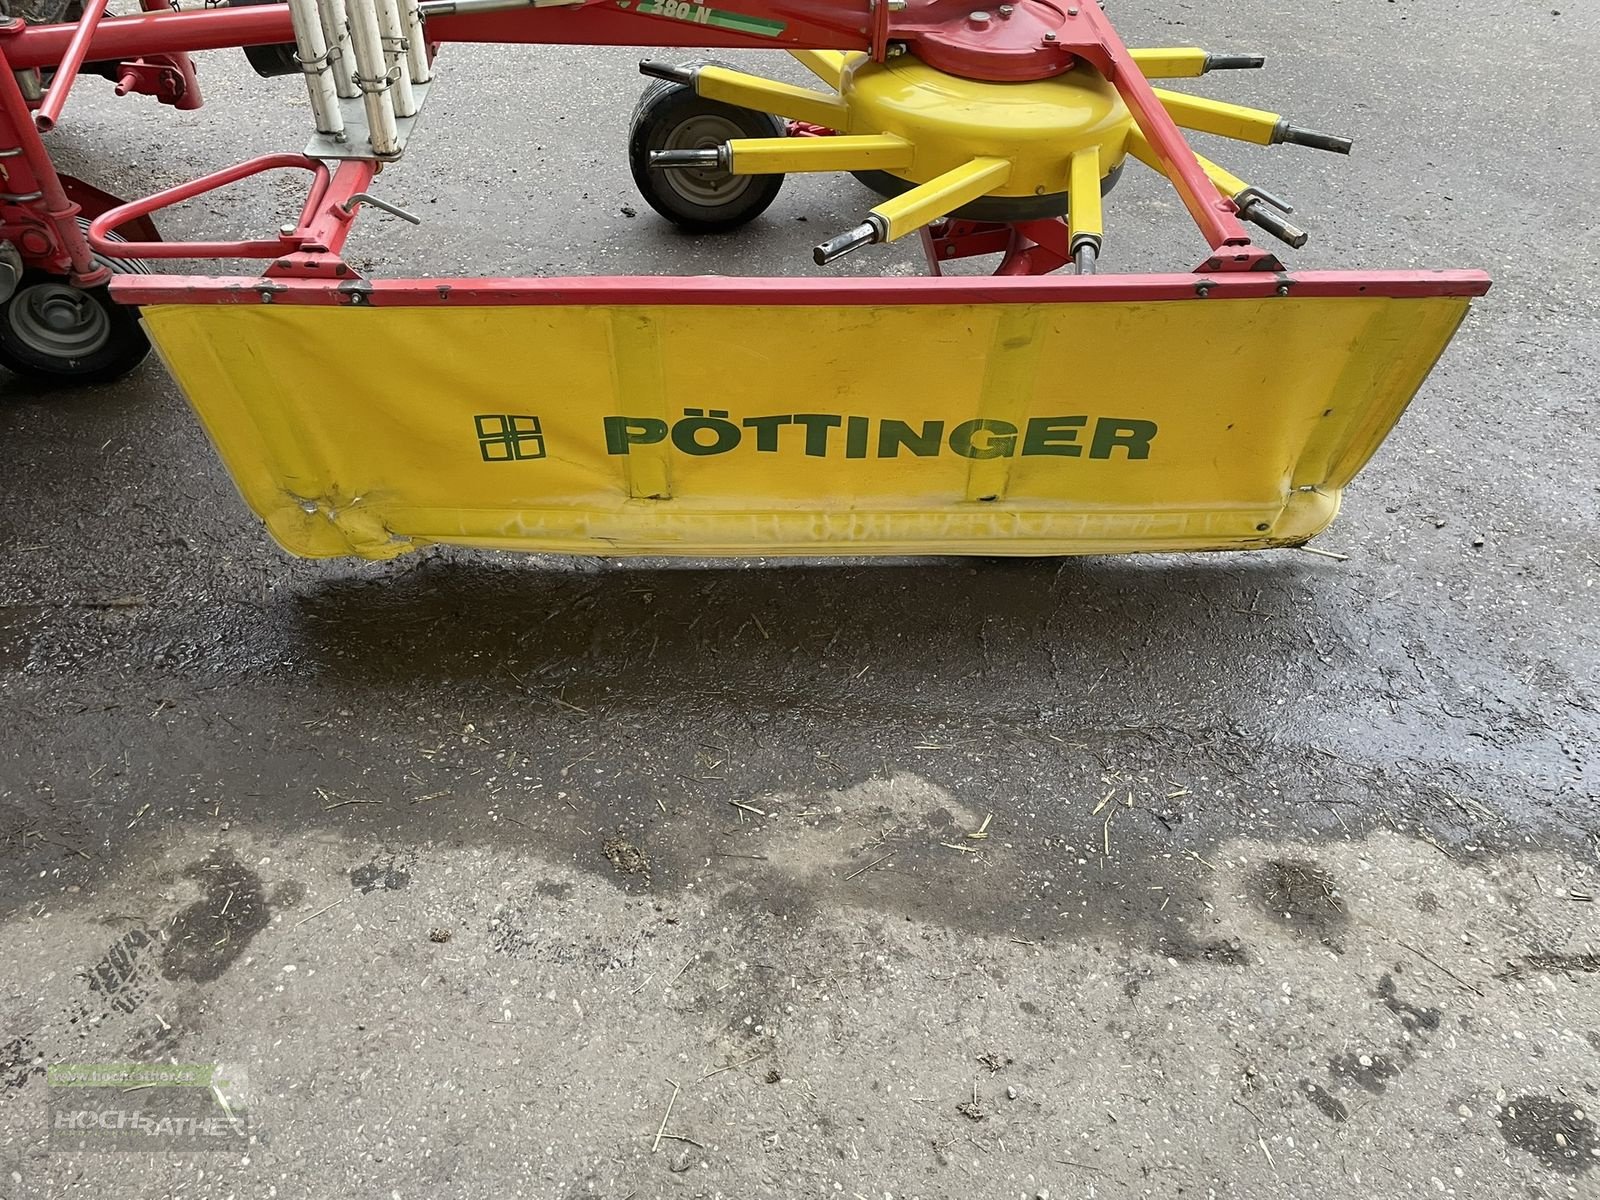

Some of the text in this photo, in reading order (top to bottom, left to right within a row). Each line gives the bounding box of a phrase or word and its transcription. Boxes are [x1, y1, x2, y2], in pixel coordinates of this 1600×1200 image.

[651, 0, 712, 24] 380 N
[604, 408, 1158, 459] PÖTTINGER
